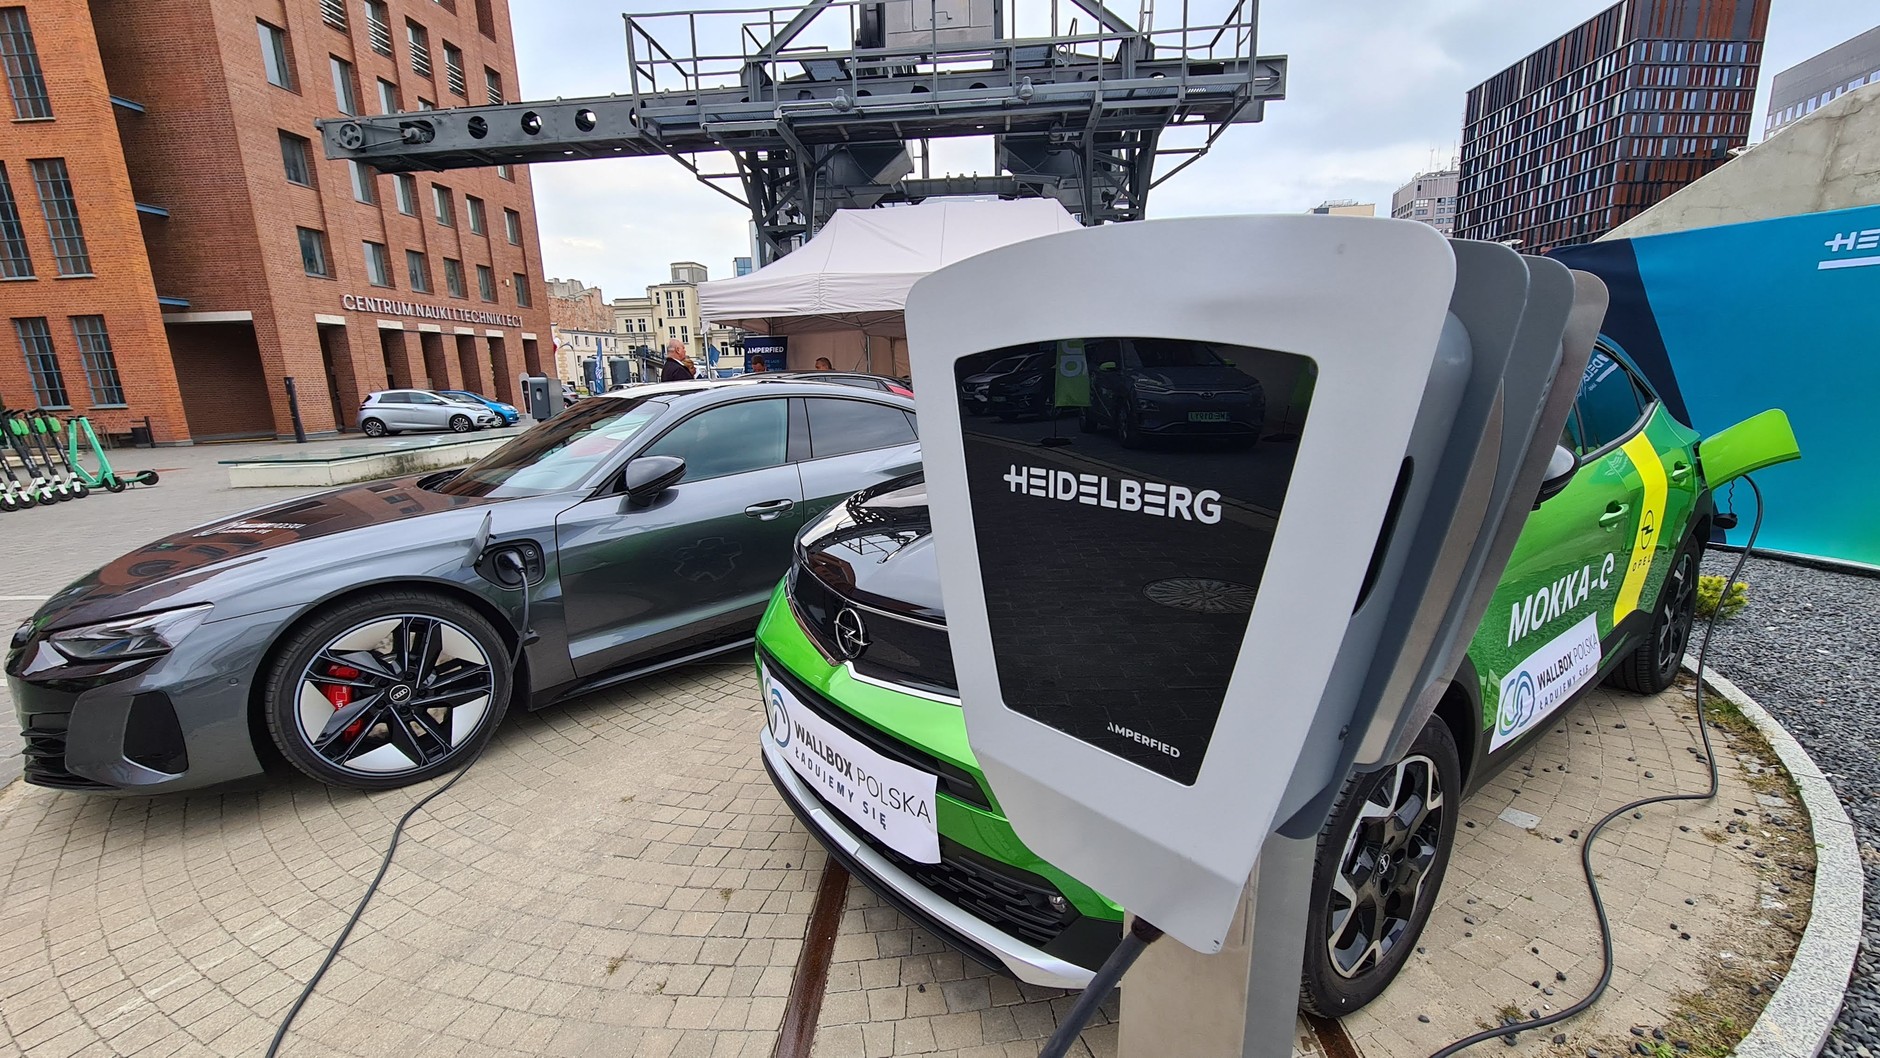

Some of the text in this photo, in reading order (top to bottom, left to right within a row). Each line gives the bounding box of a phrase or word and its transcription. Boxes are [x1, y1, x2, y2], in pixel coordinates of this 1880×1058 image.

[343, 294, 412, 316] CENTRUM
[415, 303, 452, 320] NAUKI
[458, 308, 506, 325] TECHNIKI
[506, 314, 524, 327] EC1
[747, 346, 784, 354] AMPERFIED
[1003, 464, 1222, 525] HEIDELBERG
[1632, 554, 1652, 572] OPEL
[1507, 552, 1615, 648] MOKKA-e
[1536, 632, 1599, 691] WALLBOX POLSKA
[1106, 721, 1181, 758] AMPERFIED
[794, 720, 932, 824] WALLBOX POLSKA
[795, 748, 888, 831] ŁADUJEMY SIĘ
